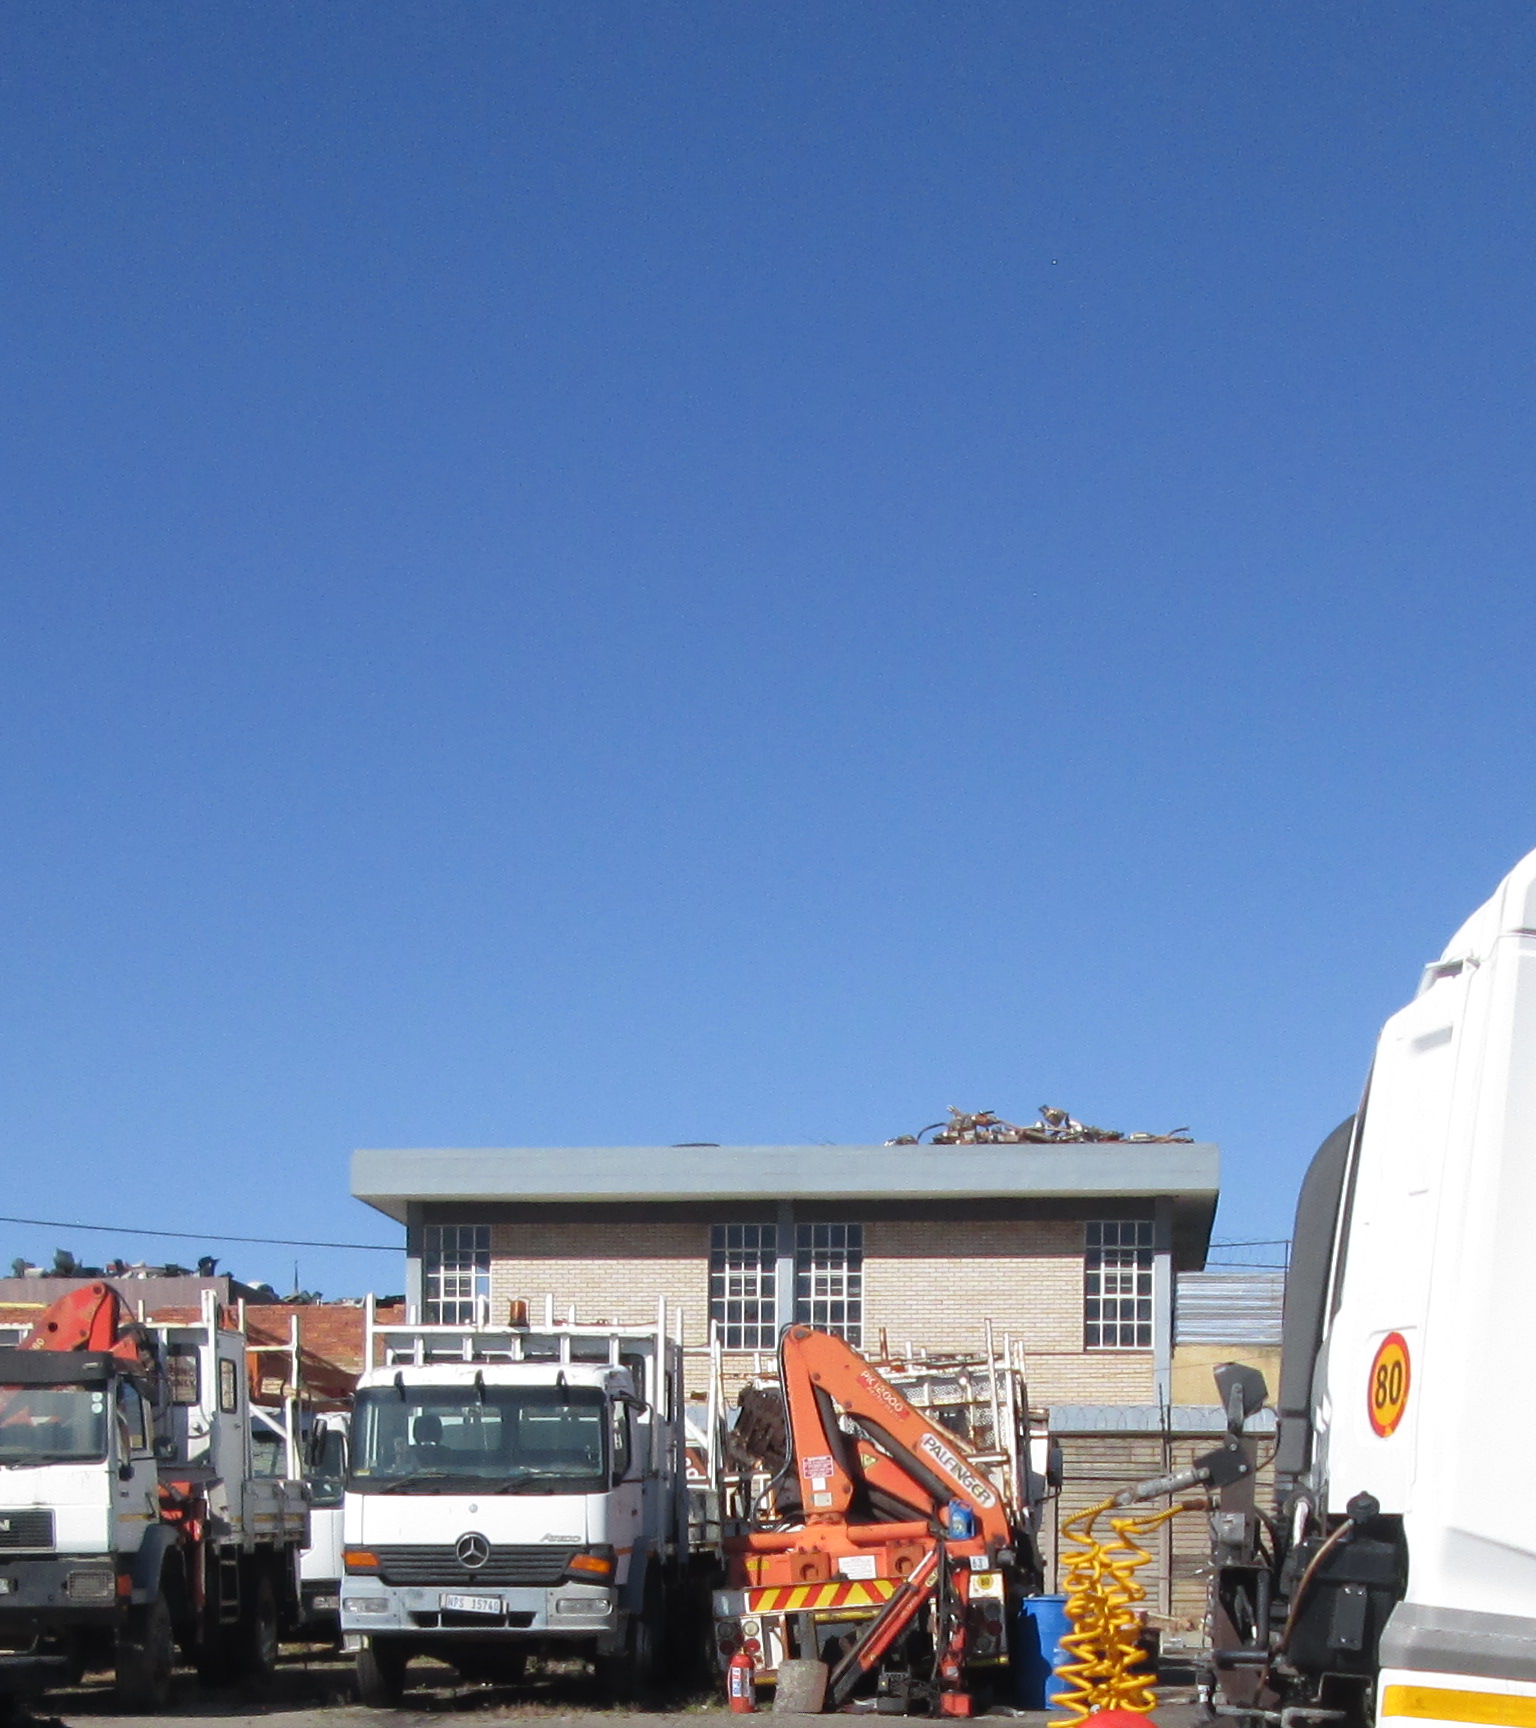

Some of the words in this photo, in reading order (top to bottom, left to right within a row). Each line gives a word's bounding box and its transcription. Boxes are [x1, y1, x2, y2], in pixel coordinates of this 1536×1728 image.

[1375, 1360, 1402, 1409] 80
[923, 1435, 991, 1504] PALFINGER
[447, 1593, 464, 1609] NPS
[471, 1597, 499, 1612] 15740
